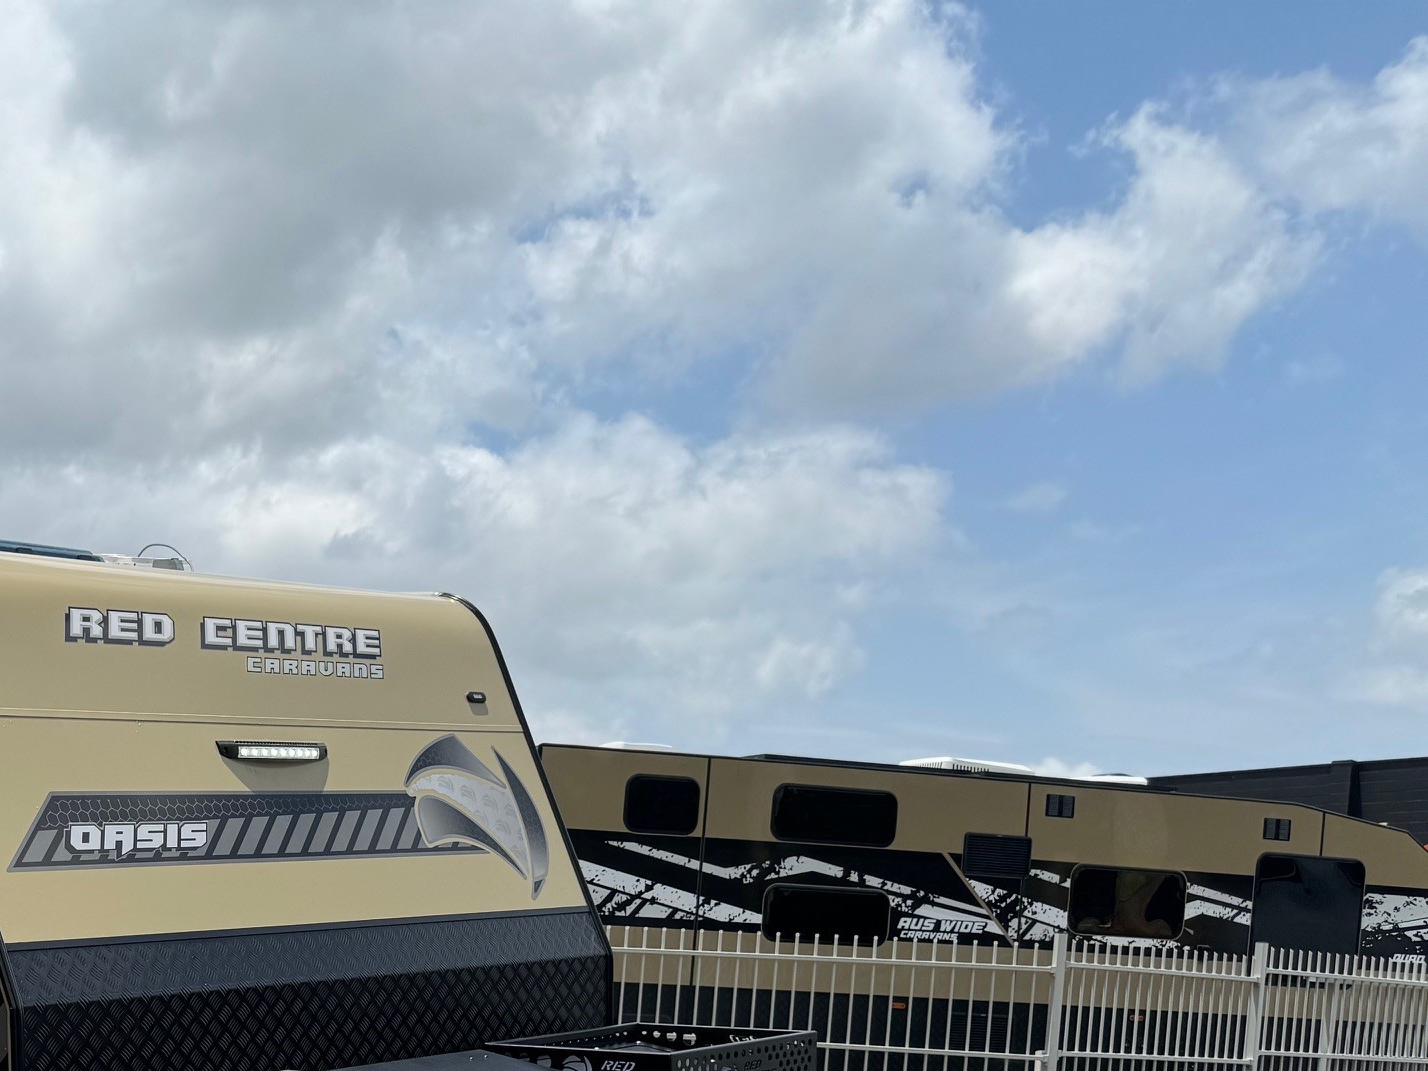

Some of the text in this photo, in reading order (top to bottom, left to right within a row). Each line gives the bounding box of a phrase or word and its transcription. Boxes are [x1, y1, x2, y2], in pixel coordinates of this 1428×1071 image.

[65, 606, 383, 659] RED CENTRE
[246, 656, 385, 680] CARAVANS
[67, 821, 208, 860] OASIS
[897, 917, 987, 934] AUS WIDE
[900, 930, 959, 941] CARAVANS
[600, 1060, 637, 1071] RED
[744, 1059, 762, 1071] RED
